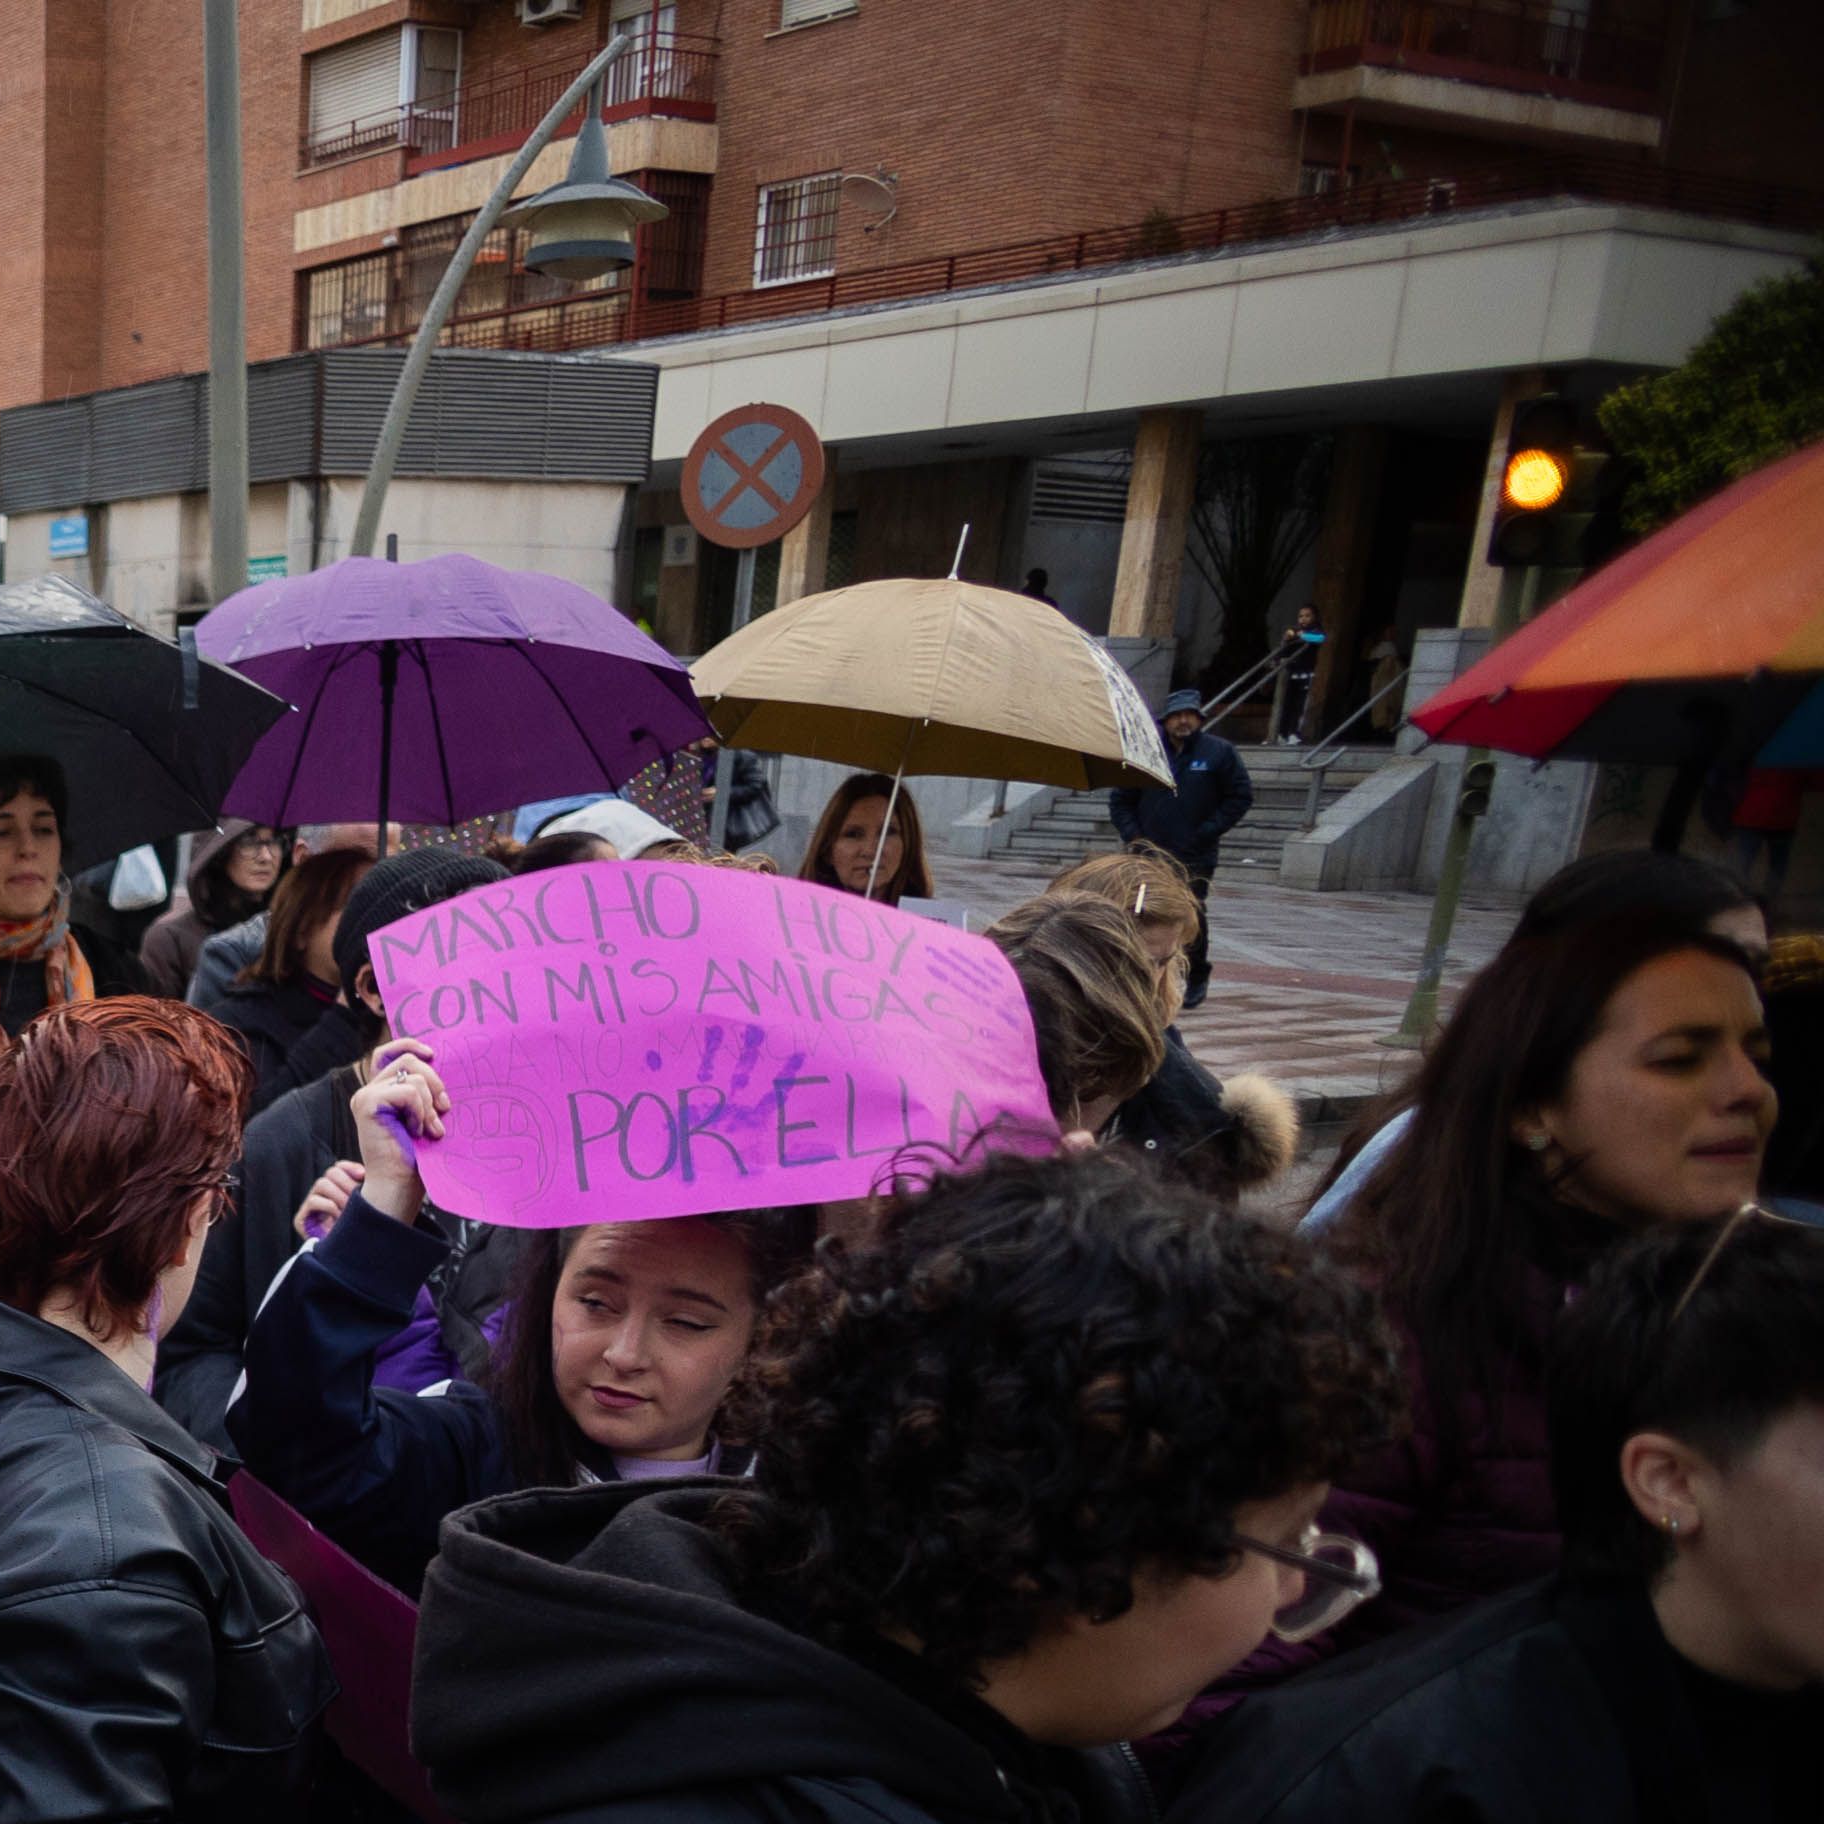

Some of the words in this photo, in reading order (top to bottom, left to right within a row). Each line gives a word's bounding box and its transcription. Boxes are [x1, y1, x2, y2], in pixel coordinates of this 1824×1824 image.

[379, 870, 701, 986] MARCHO
[772, 884, 918, 975] HOY
[394, 974, 520, 1038] CON
[568, 1084, 749, 1193] POR
